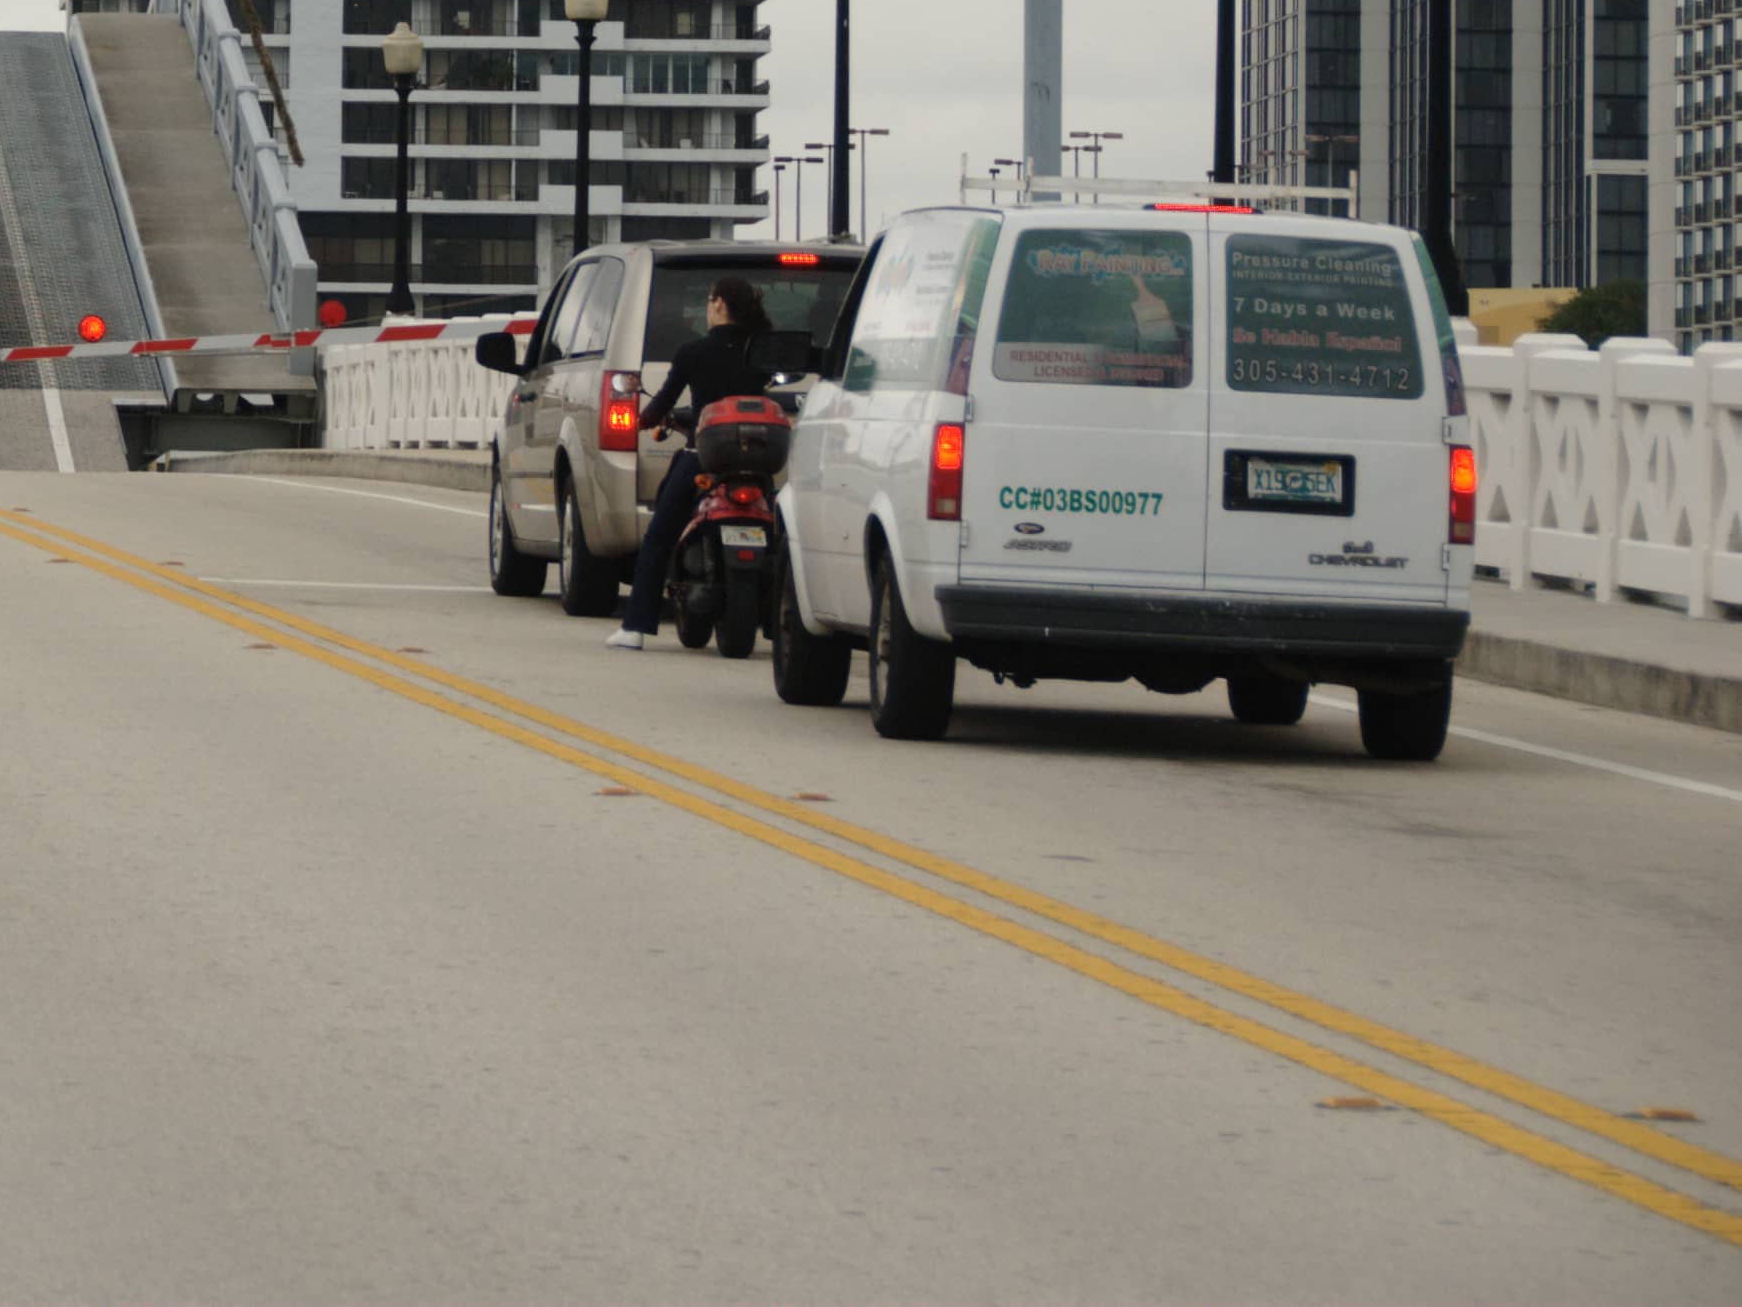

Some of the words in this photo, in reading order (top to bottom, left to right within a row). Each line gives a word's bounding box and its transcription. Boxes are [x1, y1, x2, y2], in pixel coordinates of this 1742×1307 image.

[1080, 249, 1172, 274] PAINTING
[1232, 252, 1309, 269] Pressure
[1315, 255, 1392, 278] Cleaning
[1233, 297, 1245, 313] 7
[1253, 297, 1307, 319] Days
[1315, 303, 1329, 317] a
[1336, 302, 1395, 321] Week
[1010, 349, 1088, 363] RESIDENTIAL
[1233, 358, 1410, 391] 305-431-4712
[999, 485, 1164, 515] CC#03BS00977
[1308, 553, 1410, 569] CHEVROLET
